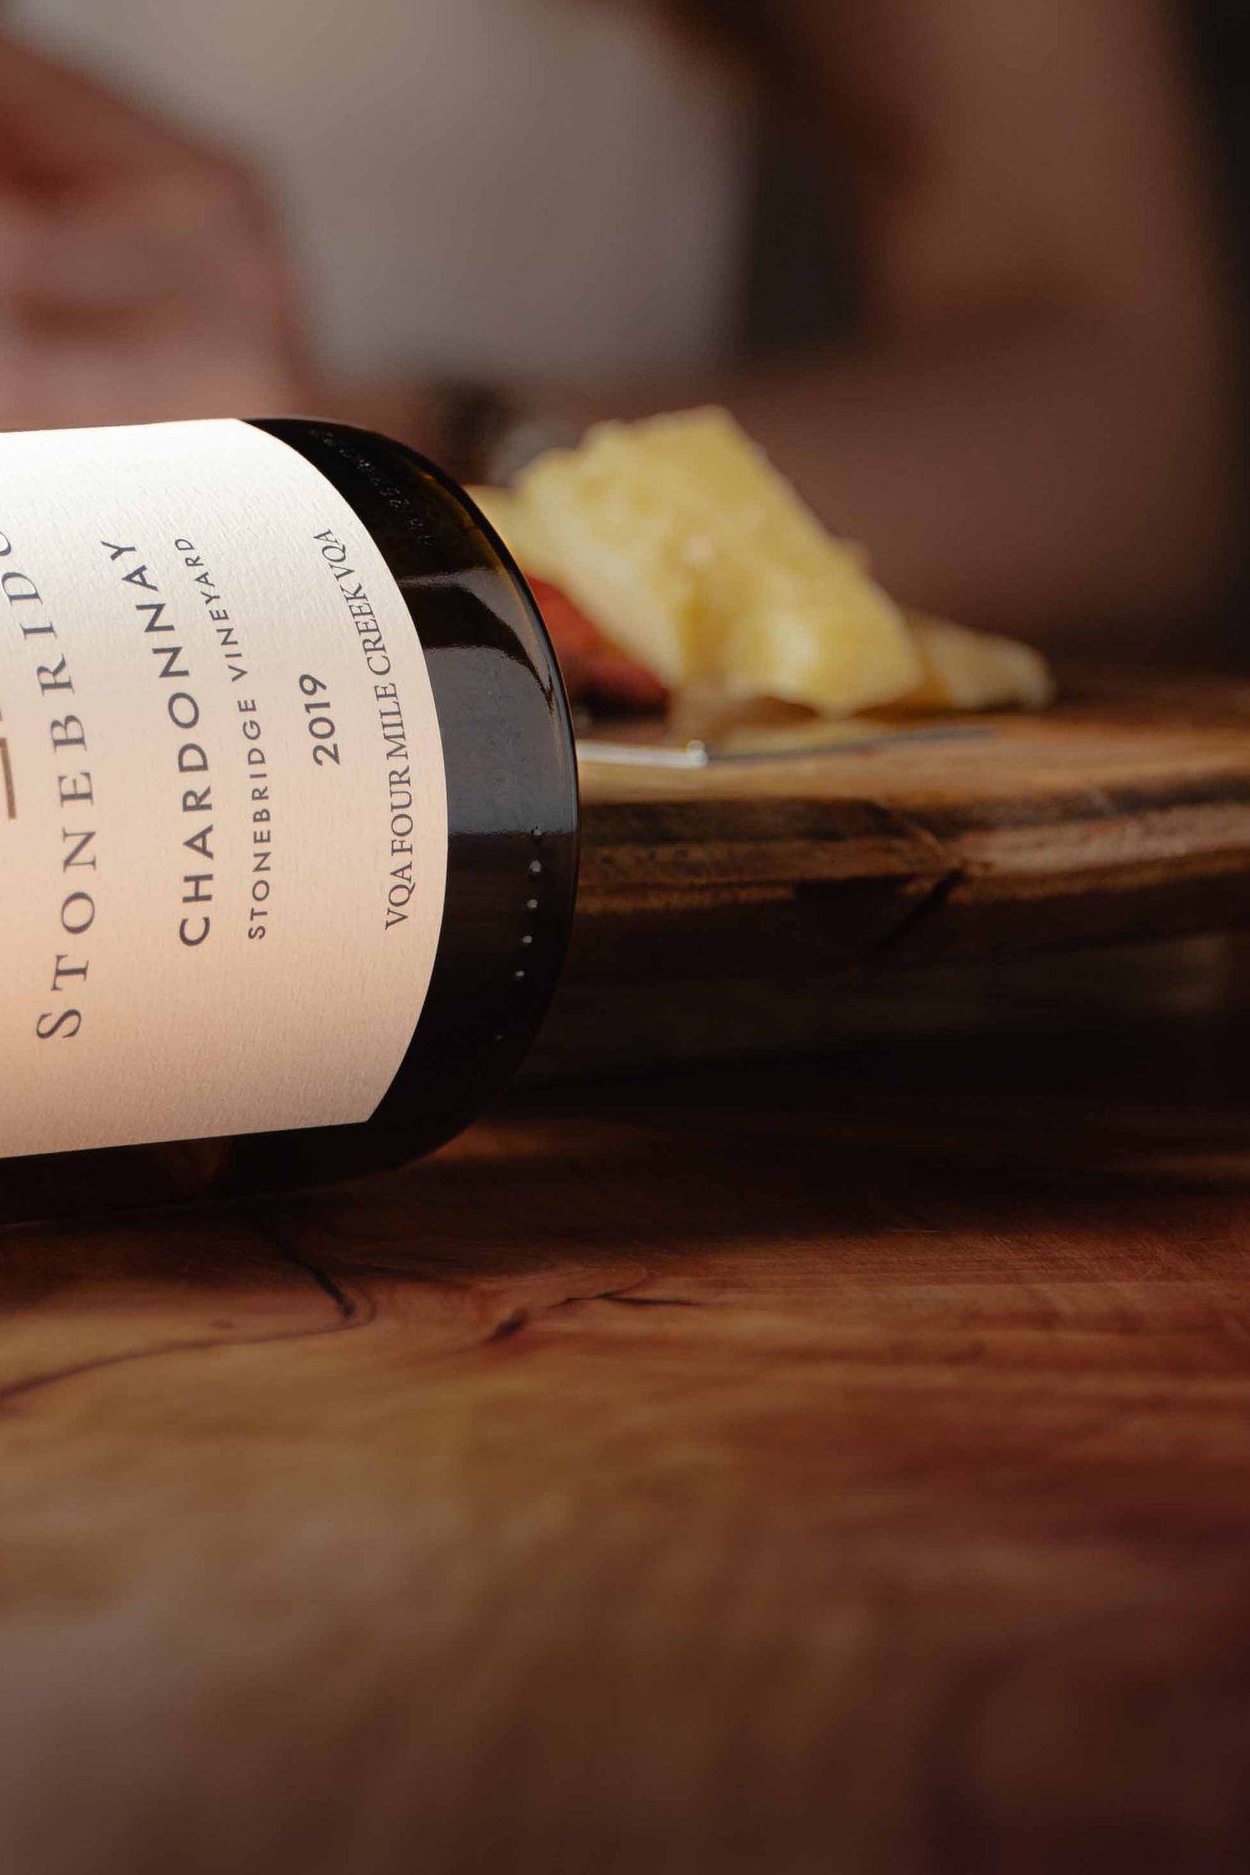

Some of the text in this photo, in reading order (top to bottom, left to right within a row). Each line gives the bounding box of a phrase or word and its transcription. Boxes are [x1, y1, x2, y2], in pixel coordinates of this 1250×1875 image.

[100, 538, 214, 948] CHARDONNAY
[174, 538, 272, 941] STONEBRIDGE VINEYARD
[298, 673, 341, 767] 2019
[312, 528, 417, 931] VQA FOUR MILE CREEK VQA
